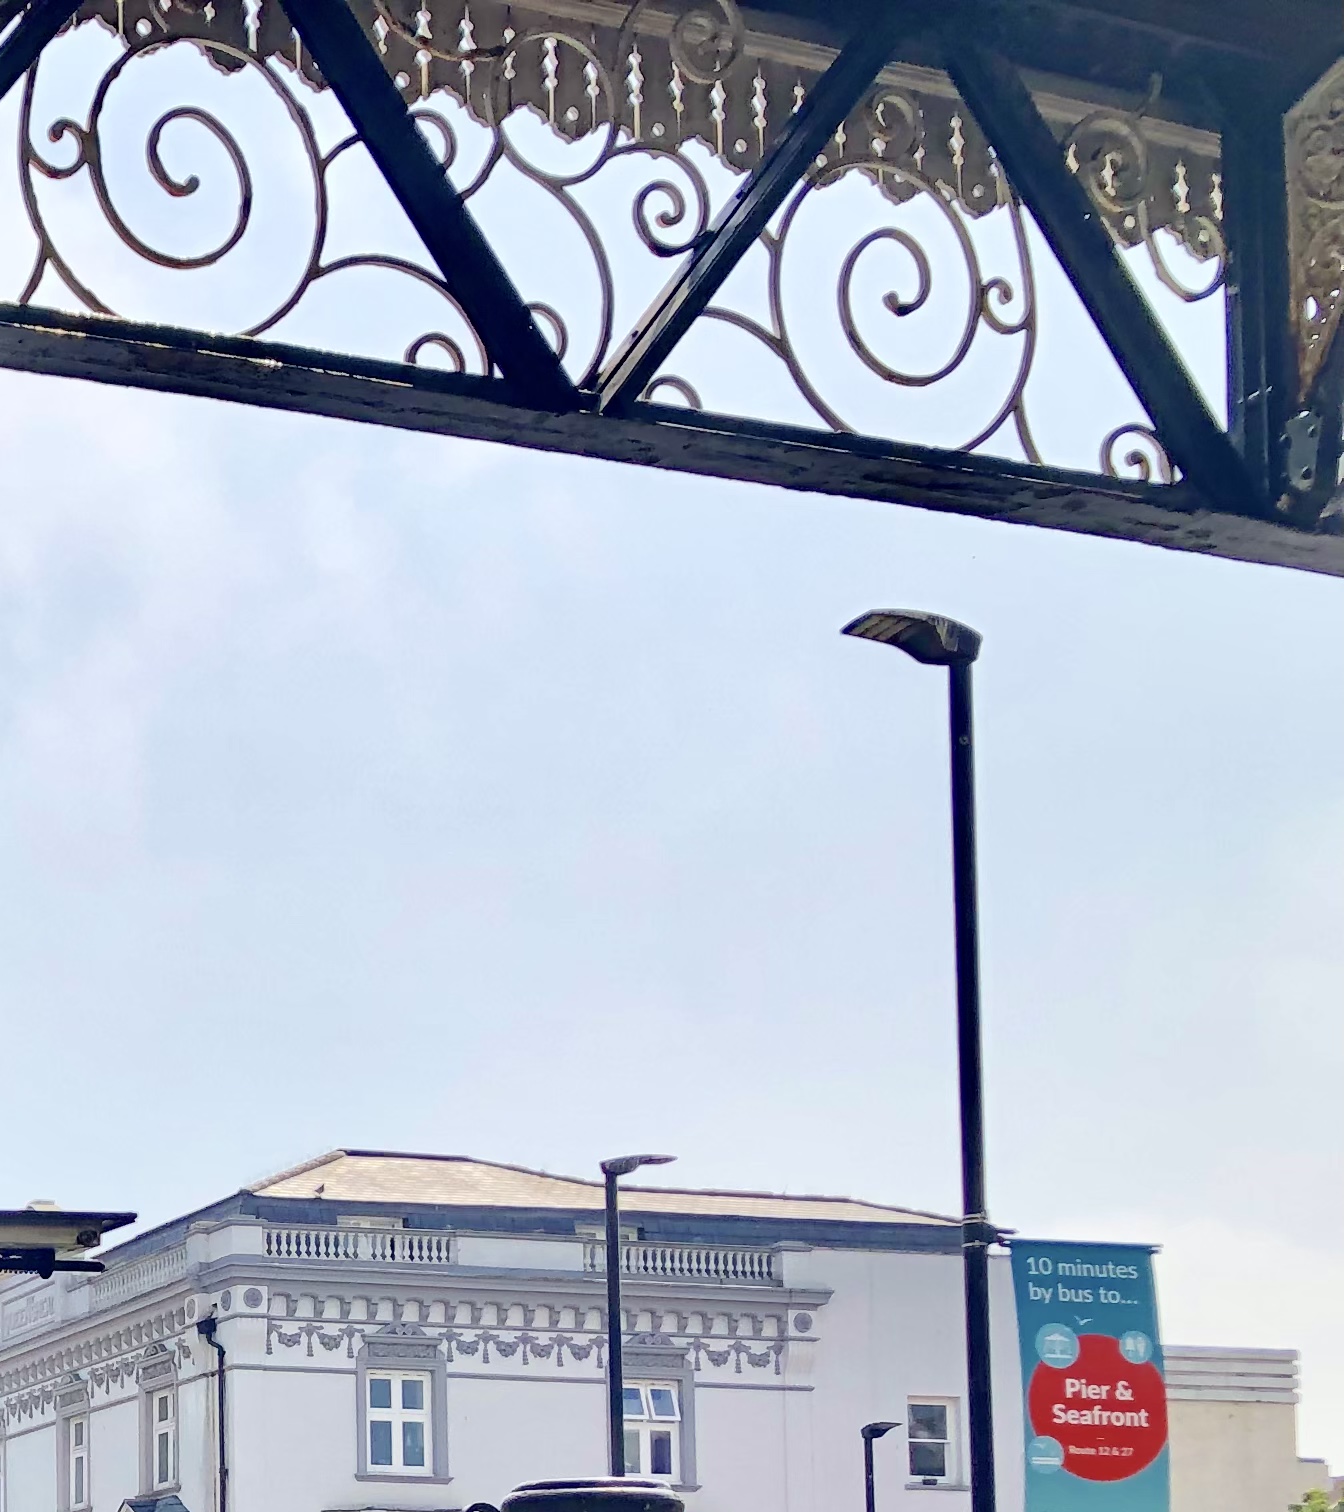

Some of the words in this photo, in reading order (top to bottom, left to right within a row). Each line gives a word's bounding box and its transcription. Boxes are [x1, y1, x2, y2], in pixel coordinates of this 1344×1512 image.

[1027, 1256, 1052, 1277] 10
[1057, 1258, 1139, 1280] minutes
[1028, 1282, 1052, 1305] by
[1057, 1283, 1094, 1304] bus
[1064, 1378, 1110, 1400] Pier
[1115, 1381, 1134, 1402] &
[1051, 1404, 1150, 1428] Seafront
